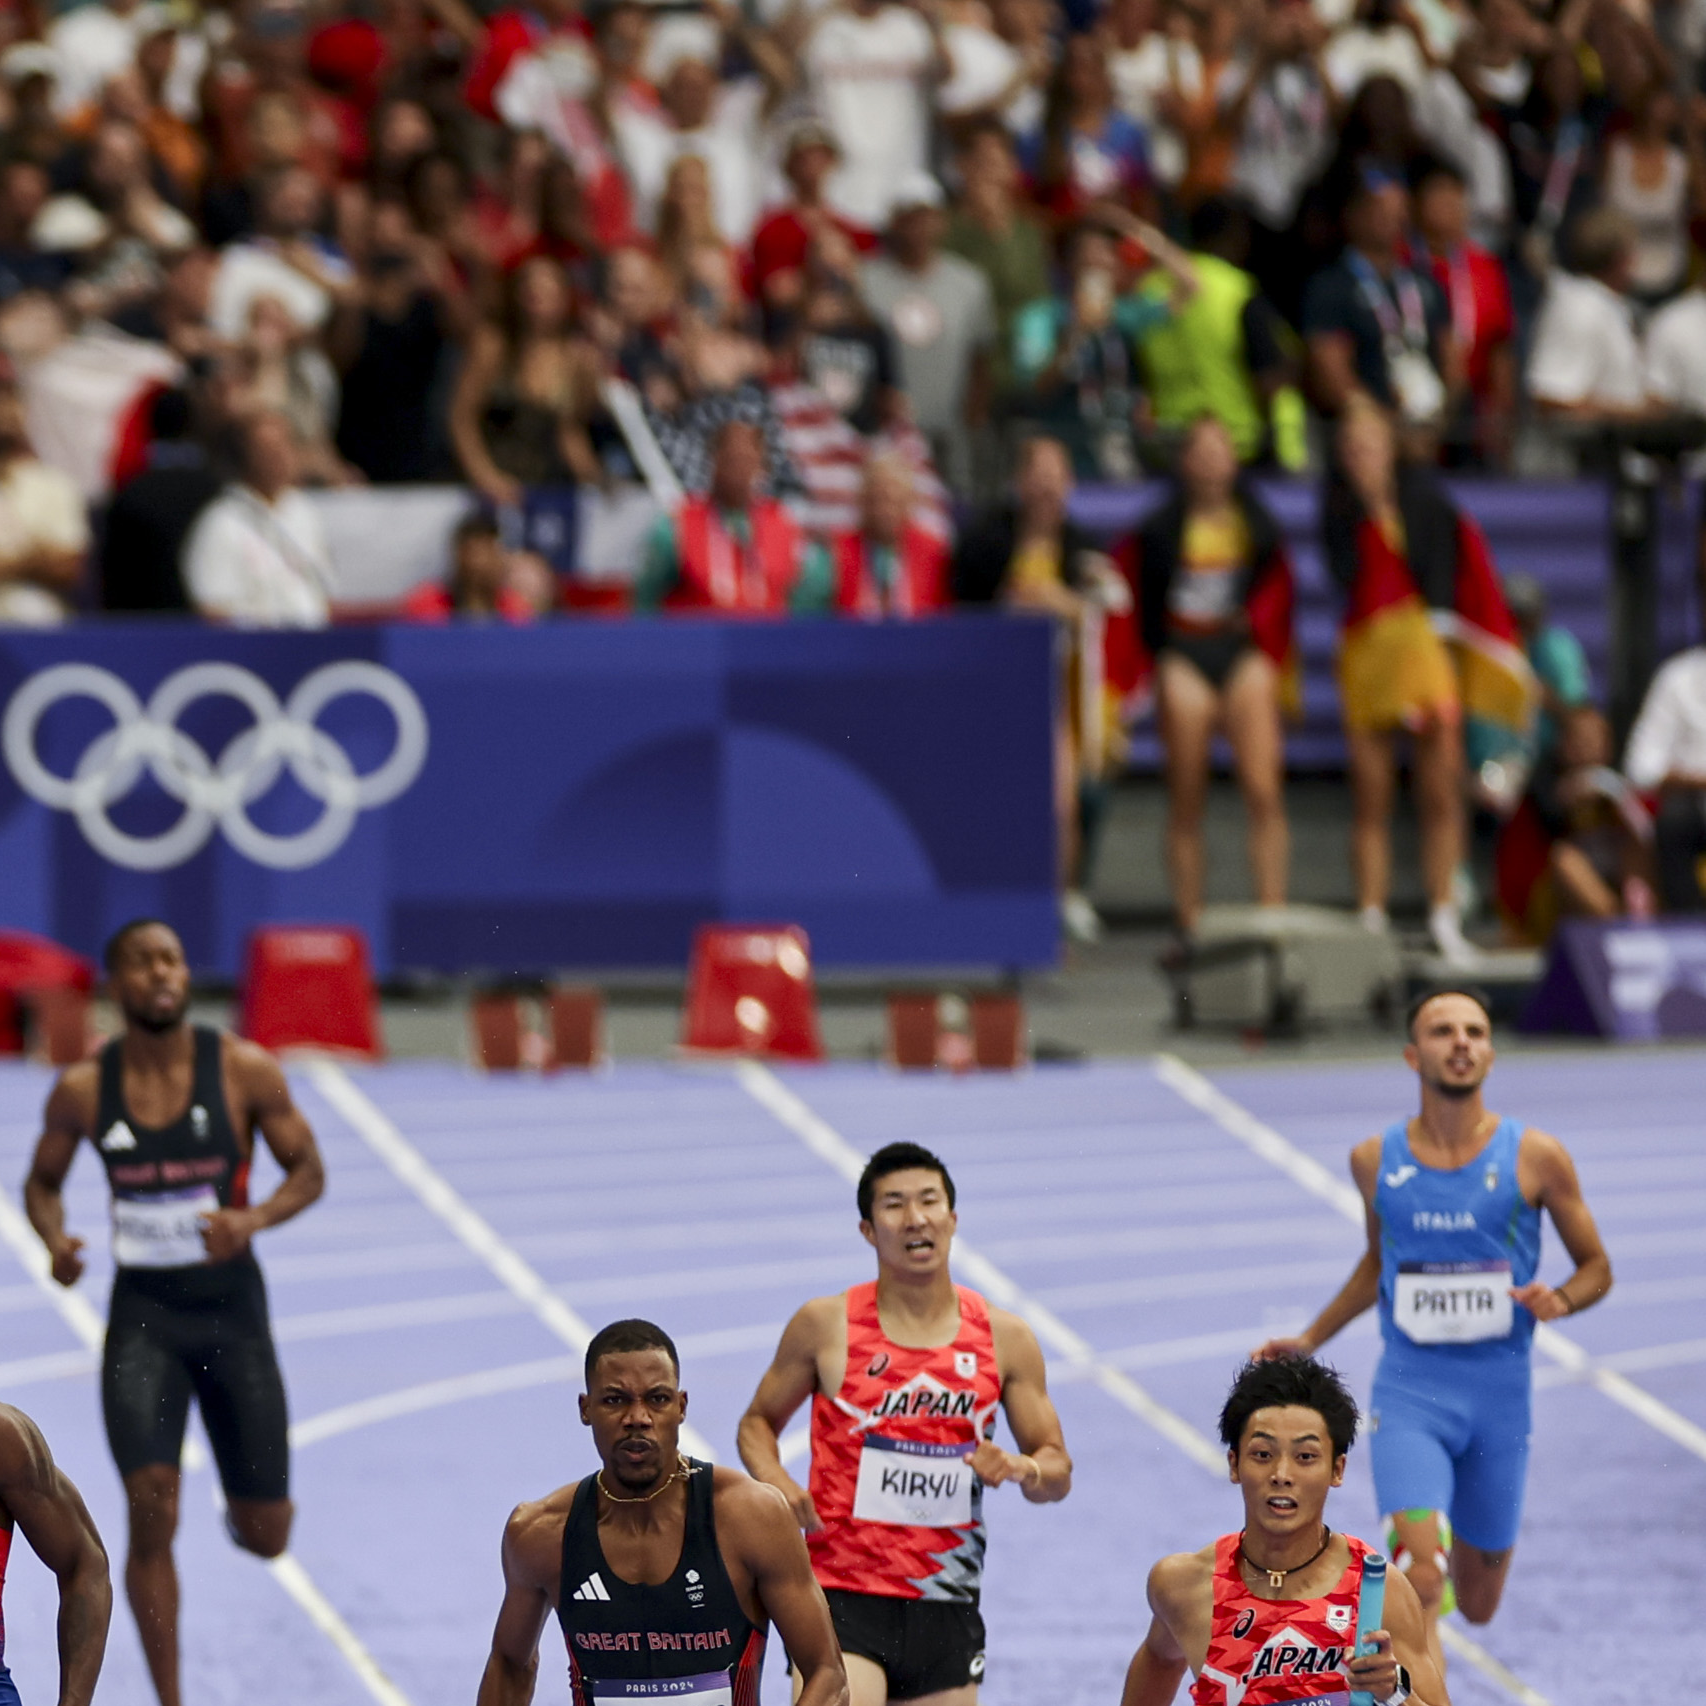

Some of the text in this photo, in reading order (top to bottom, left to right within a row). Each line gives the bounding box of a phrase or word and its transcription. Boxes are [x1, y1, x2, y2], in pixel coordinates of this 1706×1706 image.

[1412, 1211, 1477, 1230] ITALIA
[1413, 1288, 1494, 1316] PATTA
[872, 1391, 976, 1418] JAPAN
[881, 1467, 960, 1498] KIRYU
[575, 1628, 731, 1651] GREAT BRITAIN
[662, 1681, 694, 1692] 2024
